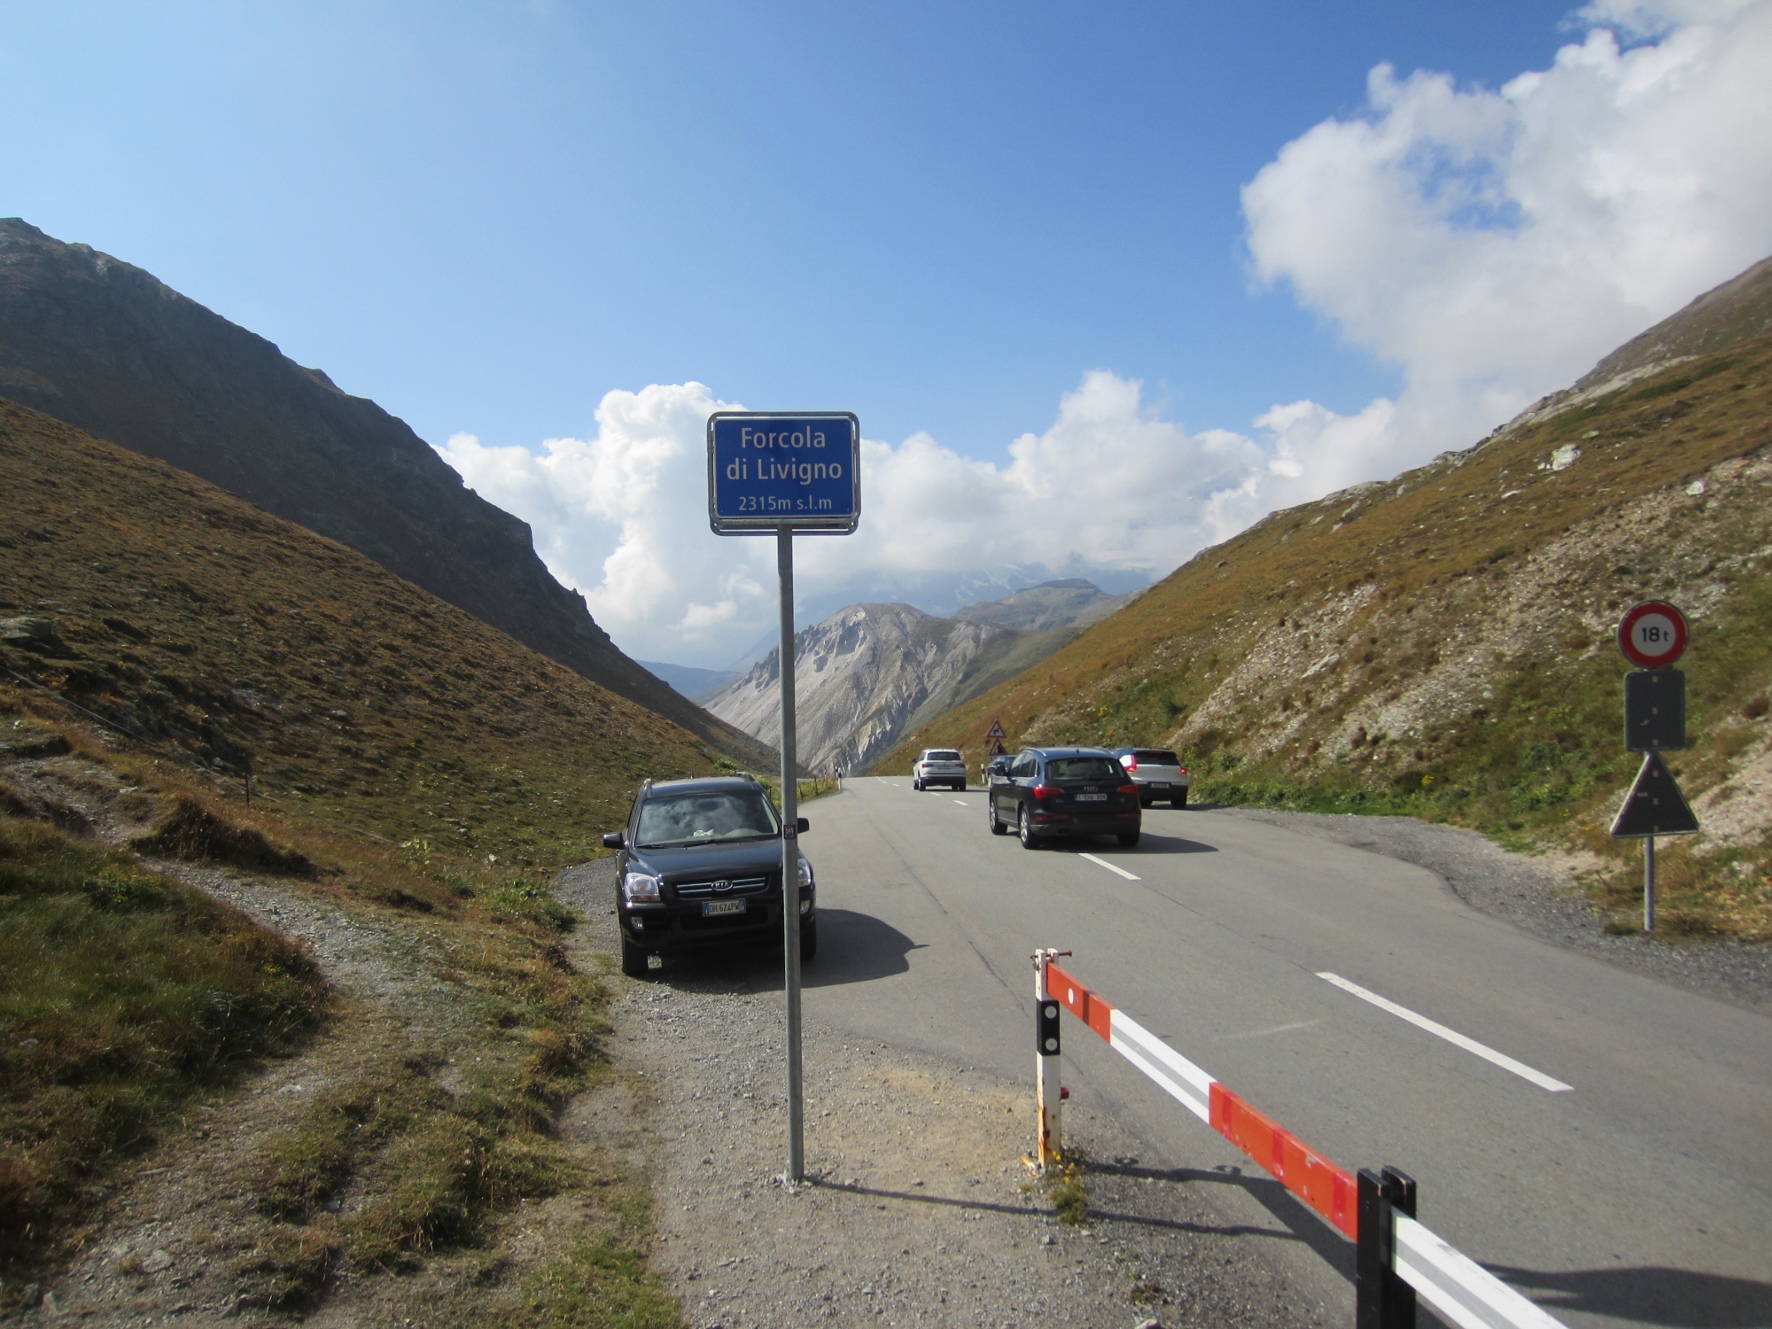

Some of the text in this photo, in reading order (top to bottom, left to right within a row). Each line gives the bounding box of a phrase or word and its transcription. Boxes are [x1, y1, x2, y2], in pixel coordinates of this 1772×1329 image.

[741, 426, 826, 448] Forcola
[726, 457, 843, 485] di Livigno
[738, 496, 791, 511] 2315m
[1642, 626, 1669, 642] 18 t
